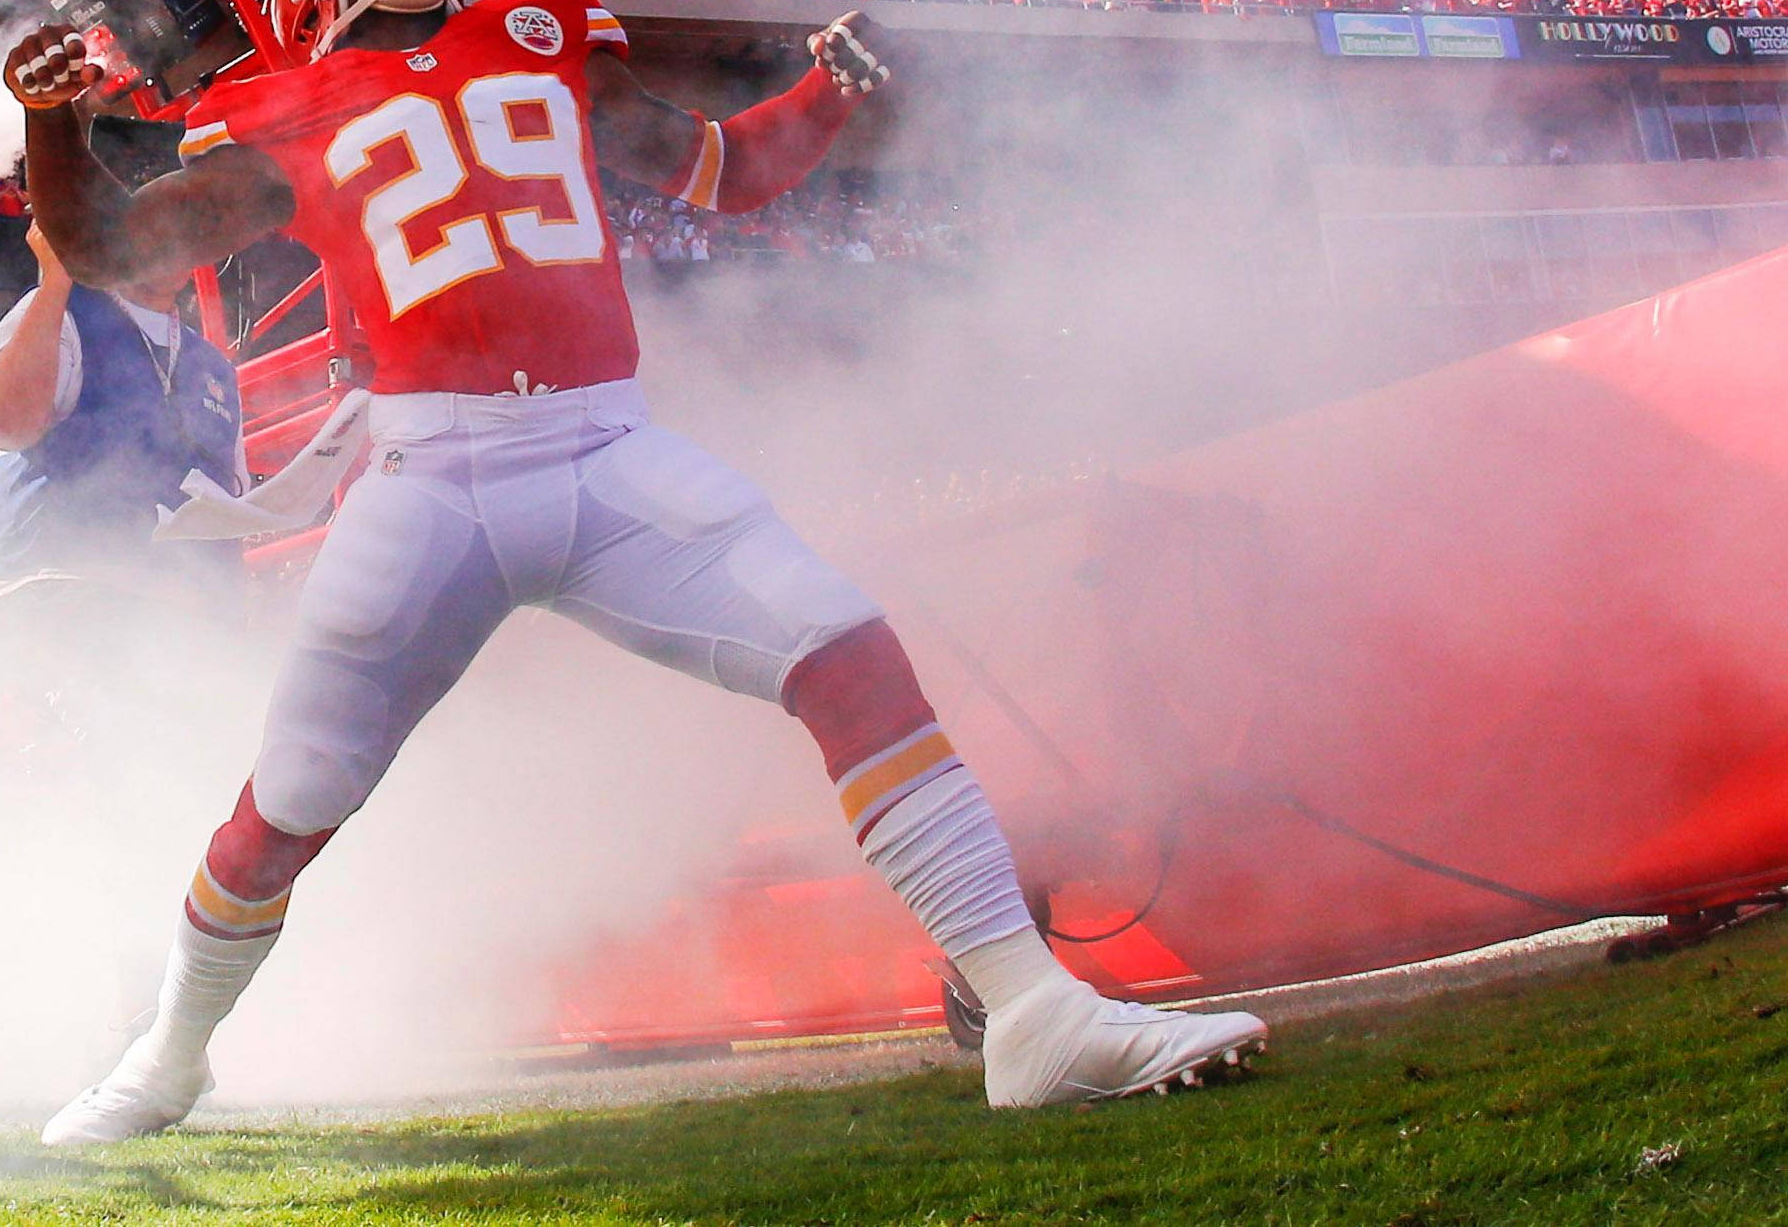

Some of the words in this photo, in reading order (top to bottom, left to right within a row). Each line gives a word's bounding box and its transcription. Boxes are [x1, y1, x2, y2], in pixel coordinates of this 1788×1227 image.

[1540, 20, 1680, 49] HOLLYWOOD
[1736, 26, 1788, 38] ARISTOCR
[323, 71, 606, 321] 29
